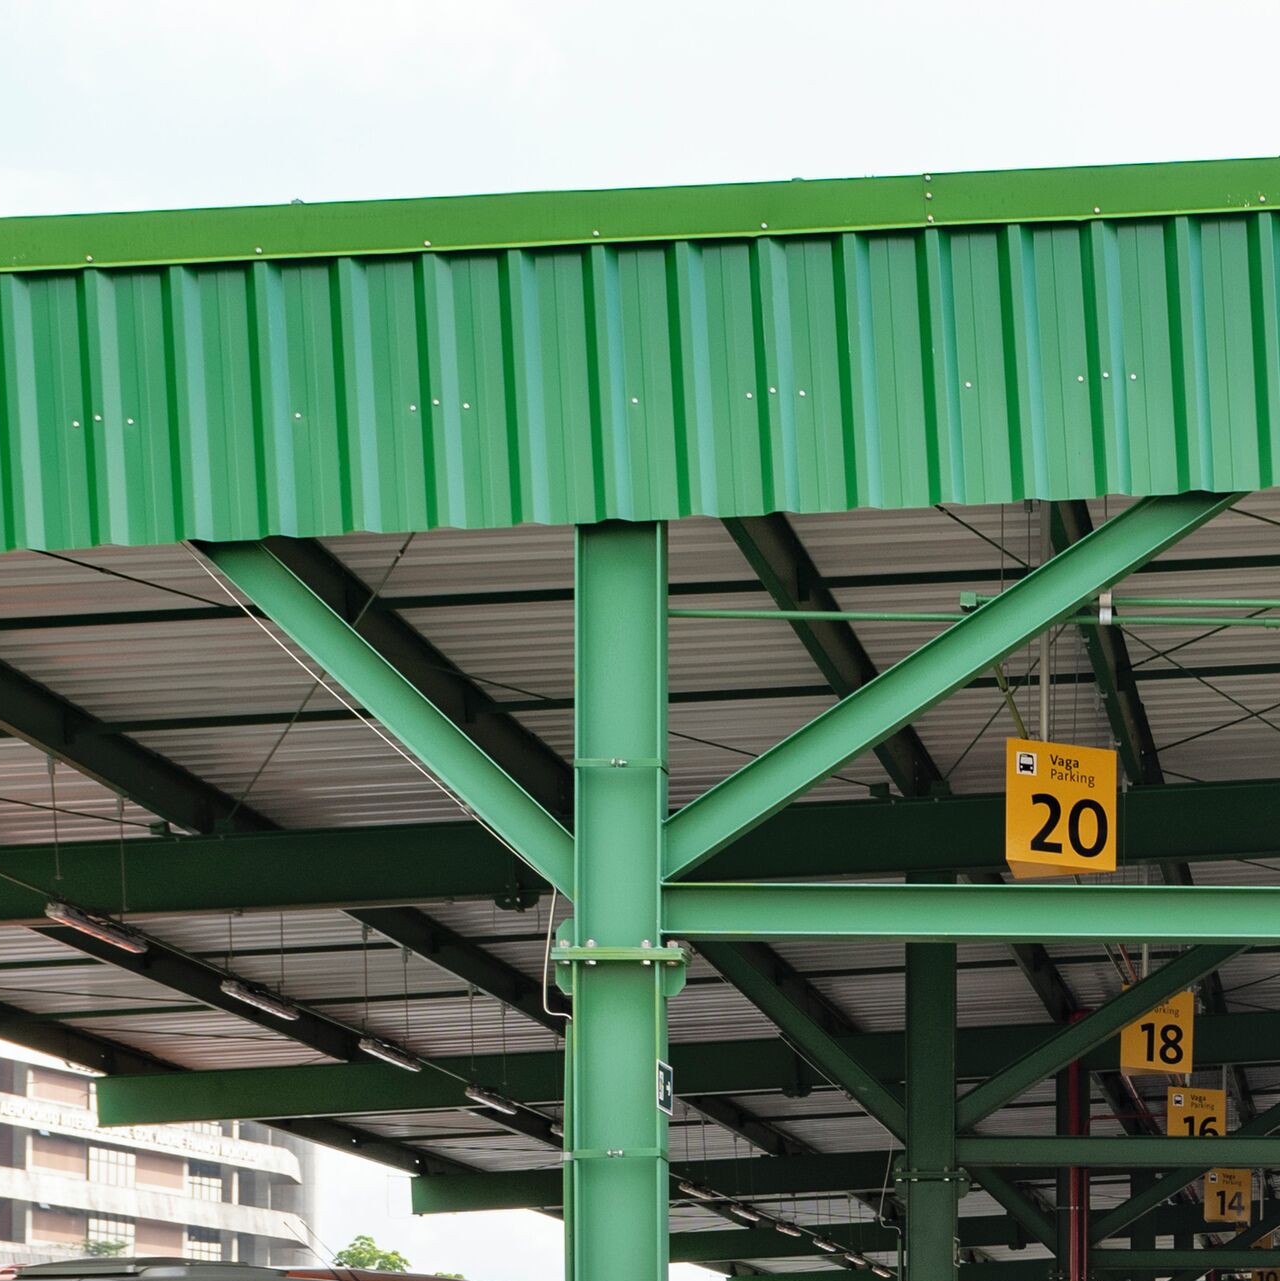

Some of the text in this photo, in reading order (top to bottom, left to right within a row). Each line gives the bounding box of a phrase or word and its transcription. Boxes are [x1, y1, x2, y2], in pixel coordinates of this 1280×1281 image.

[1049, 753, 1080, 771] Vaga
[1049, 768, 1096, 789] Parking
[1030, 792, 1109, 858] 20
[1154, 1005, 1181, 1018] arking
[1140, 1022, 1184, 1065] 18
[1190, 1094, 1207, 1103] Vaga
[1183, 1115, 1219, 1136] 16
[1216, 1190, 1245, 1216] 14
